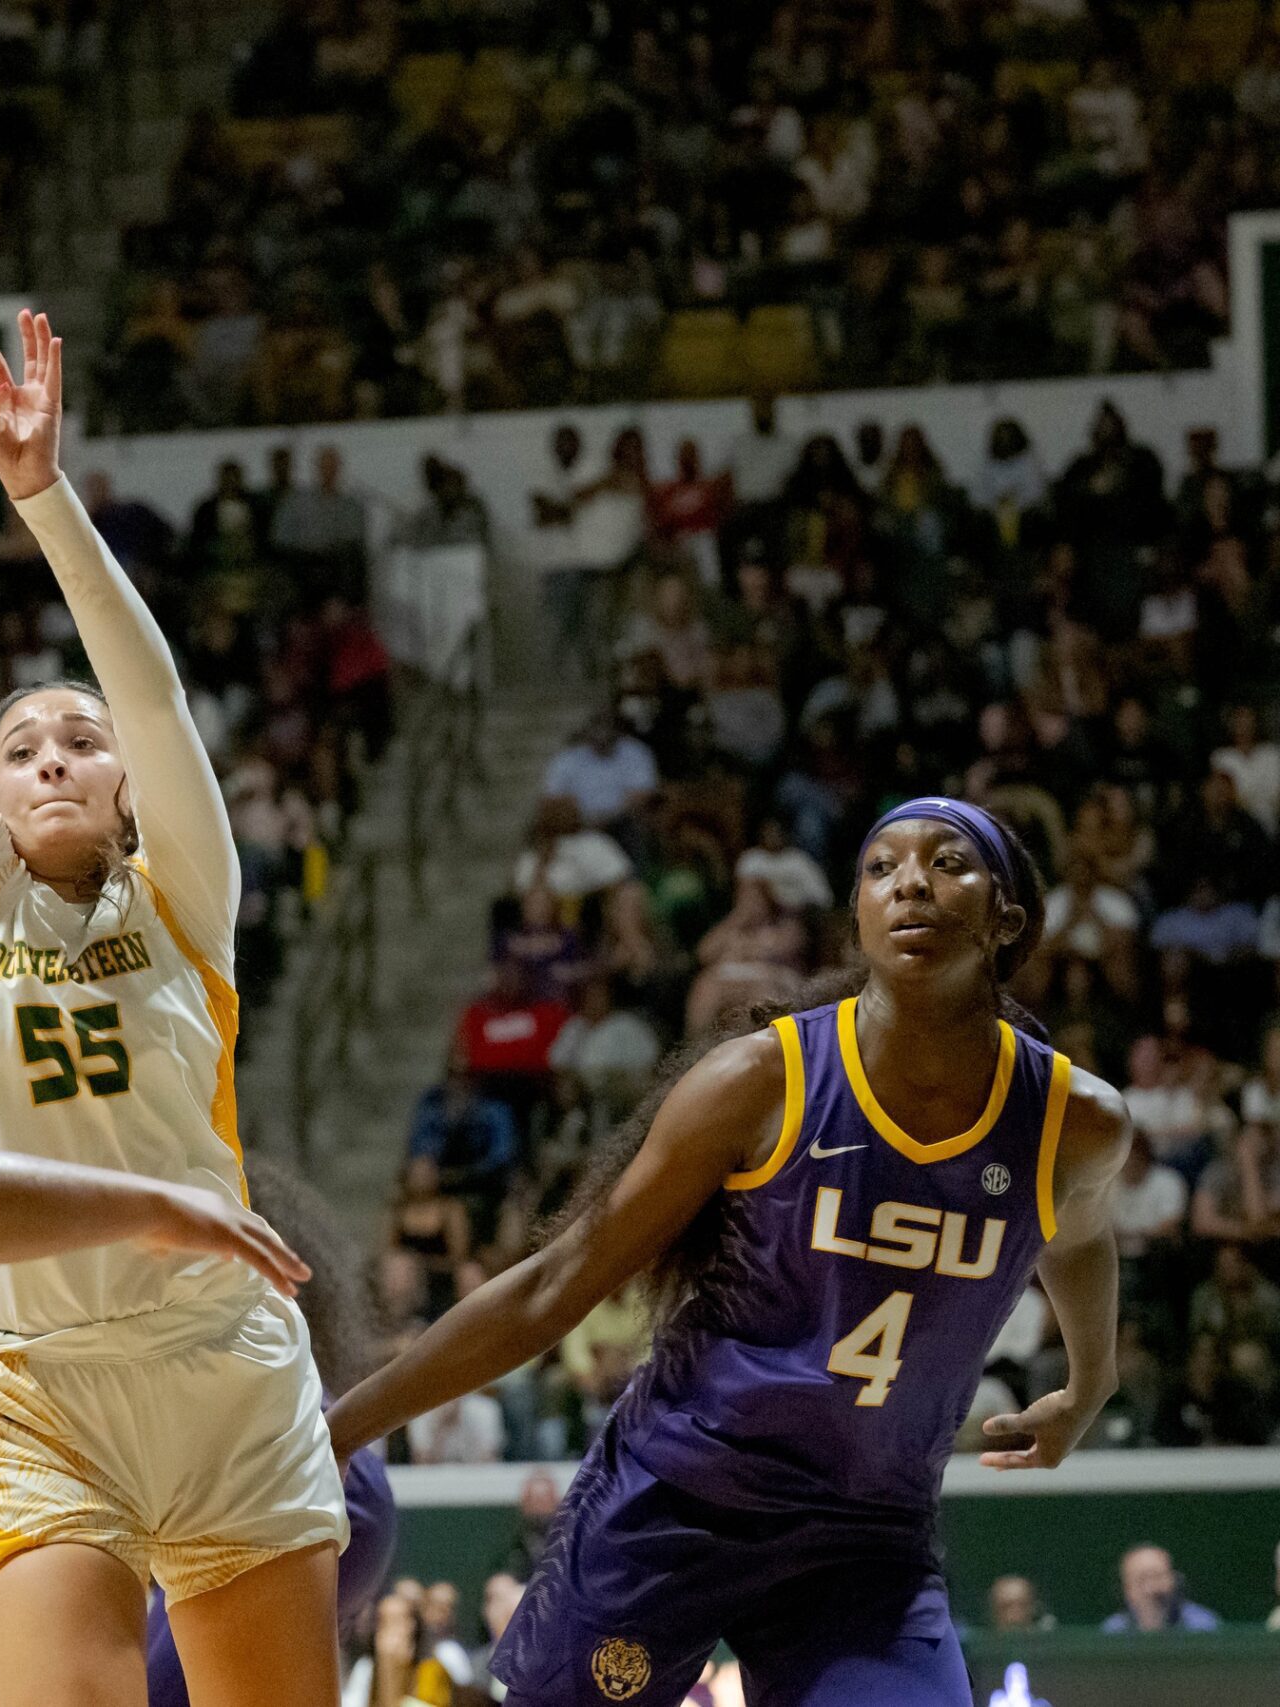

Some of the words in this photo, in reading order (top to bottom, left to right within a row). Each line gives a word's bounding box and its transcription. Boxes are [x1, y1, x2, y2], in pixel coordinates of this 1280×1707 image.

[15, 1001, 132, 1107] 55
[983, 1165, 1009, 1193] SEC
[811, 1186, 1006, 1280] LSU
[826, 1290, 914, 1407] 4
